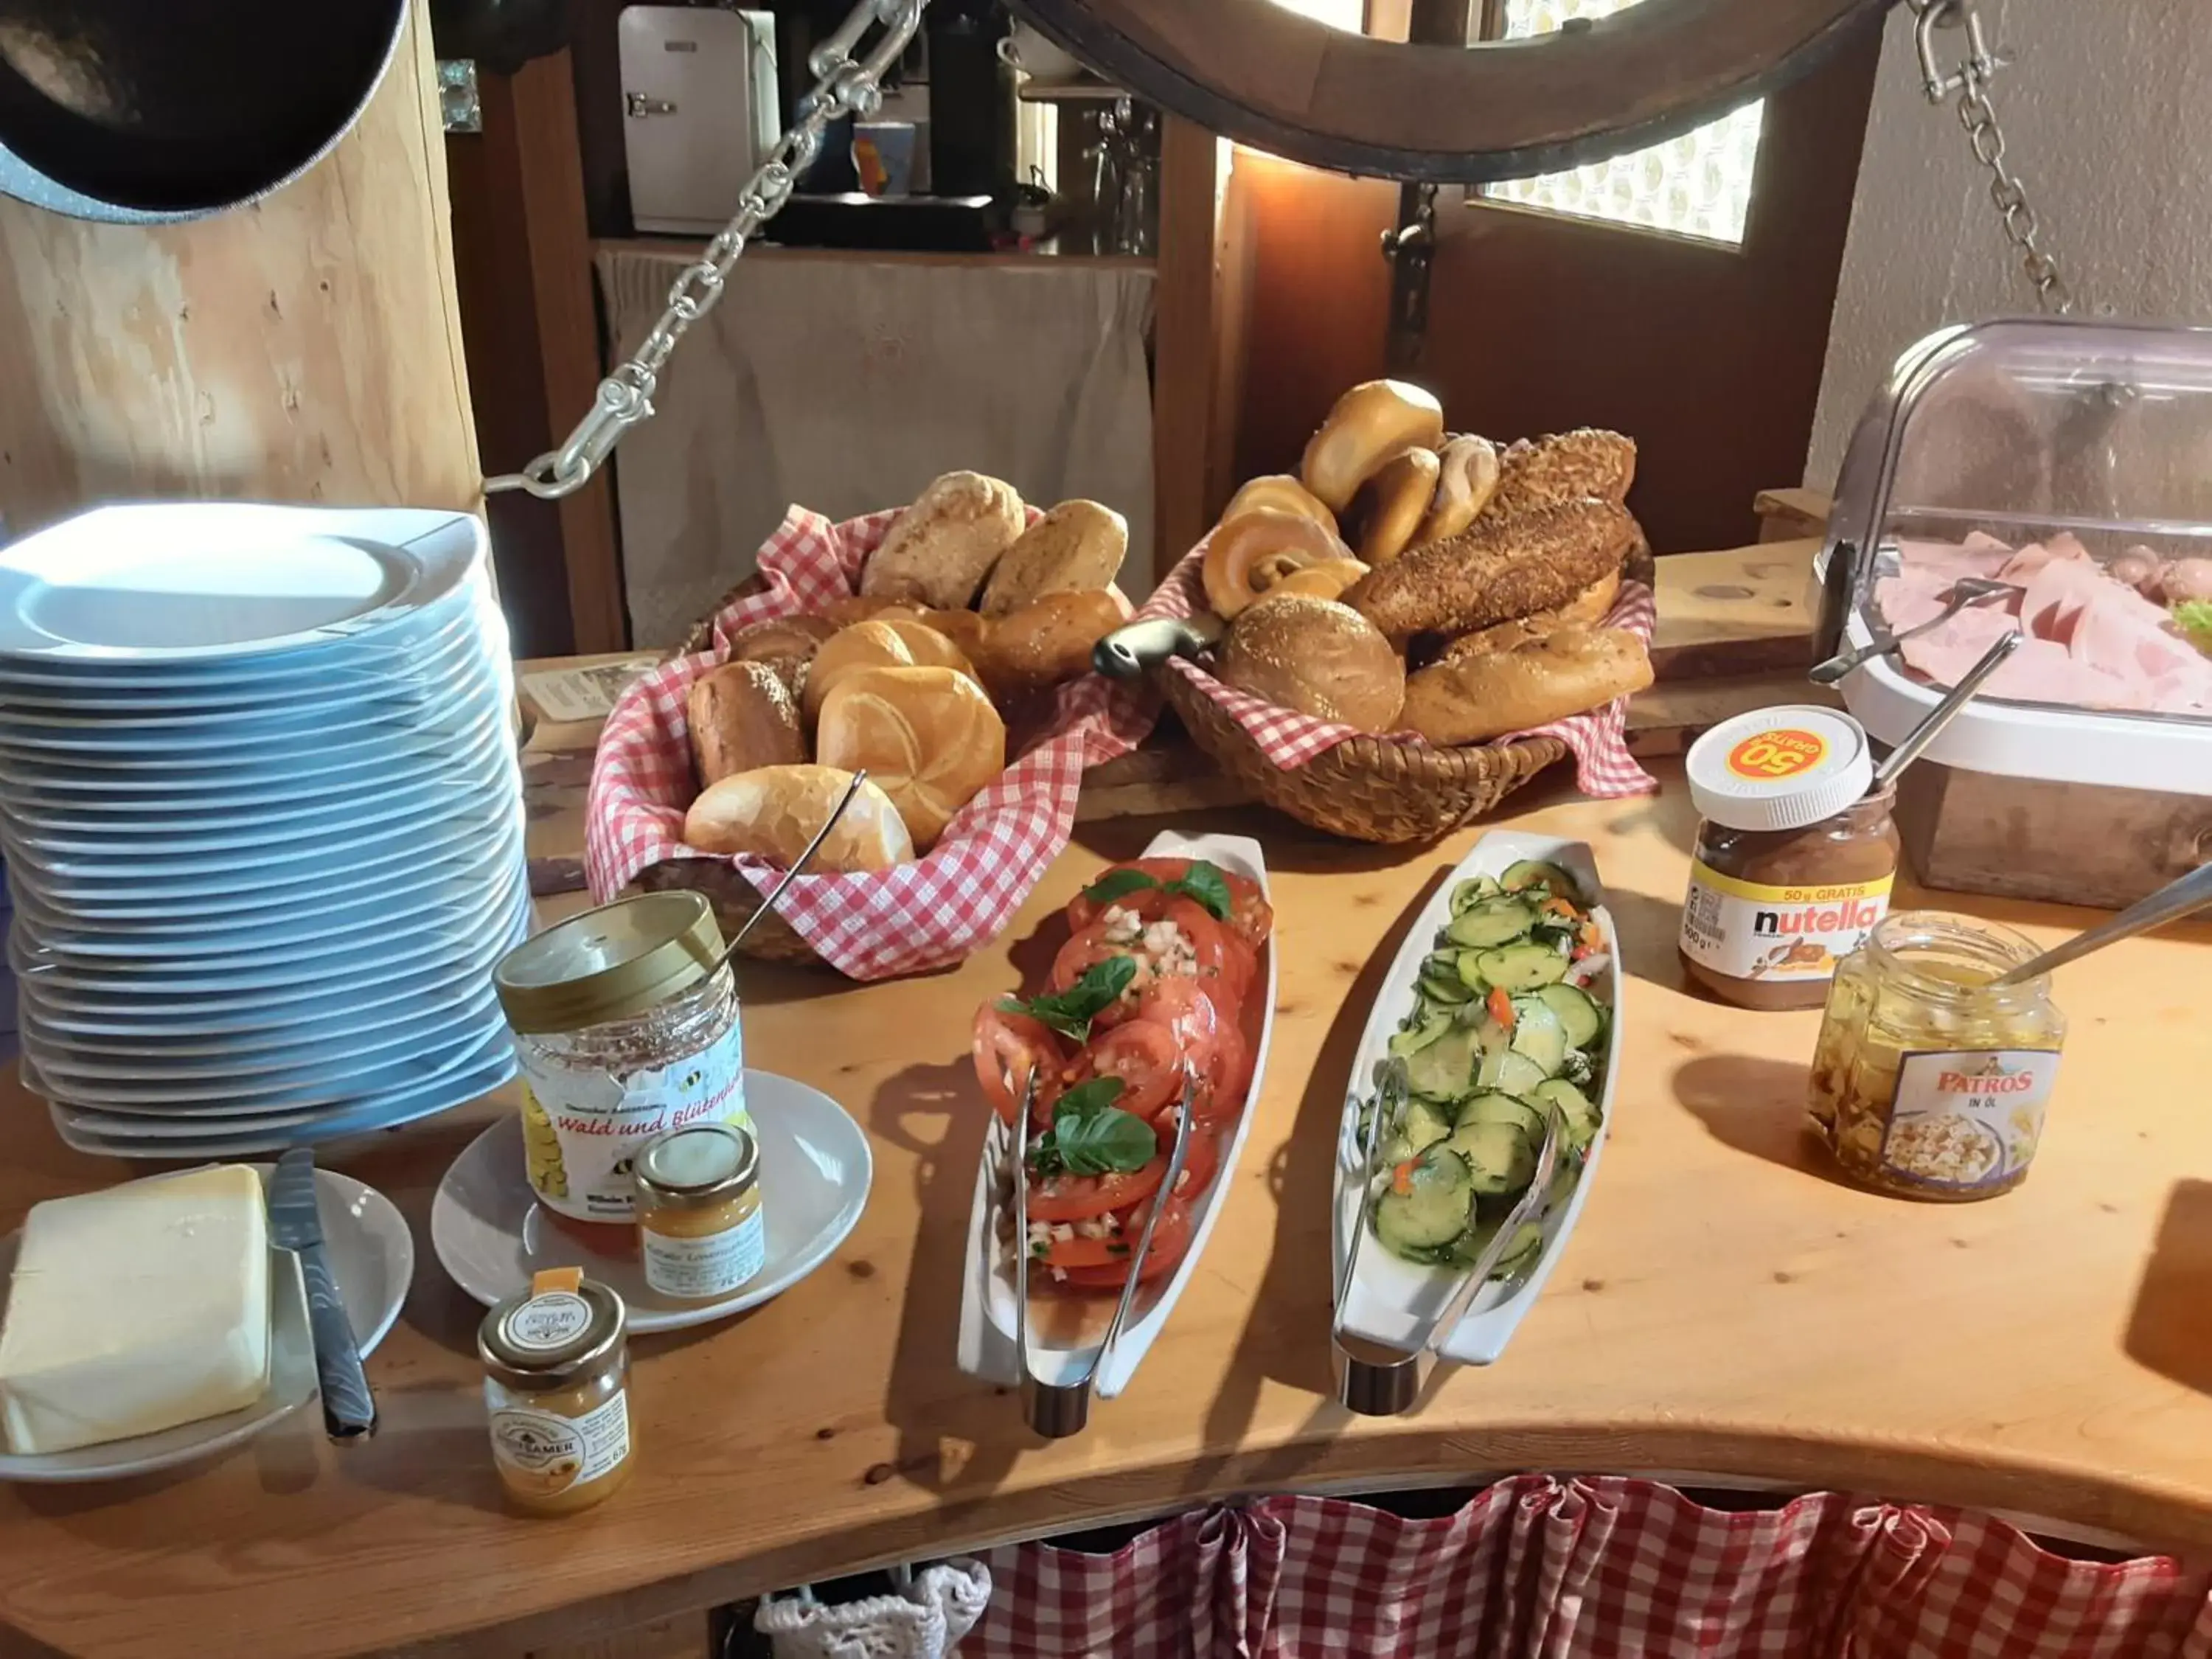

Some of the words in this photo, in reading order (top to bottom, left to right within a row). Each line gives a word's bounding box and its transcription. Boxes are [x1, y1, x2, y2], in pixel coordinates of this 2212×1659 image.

[1766, 732, 1820, 754] GRATIS
[1740, 742, 1804, 774] 50
[1784, 890, 1802, 901] 50
[1816, 886, 1865, 900] GRATIS
[1753, 899, 1878, 935] nutella
[1937, 1071, 2034, 1093] PATROS
[557, 1115, 615, 1135] Wald
[618, 1112, 667, 1135] und
